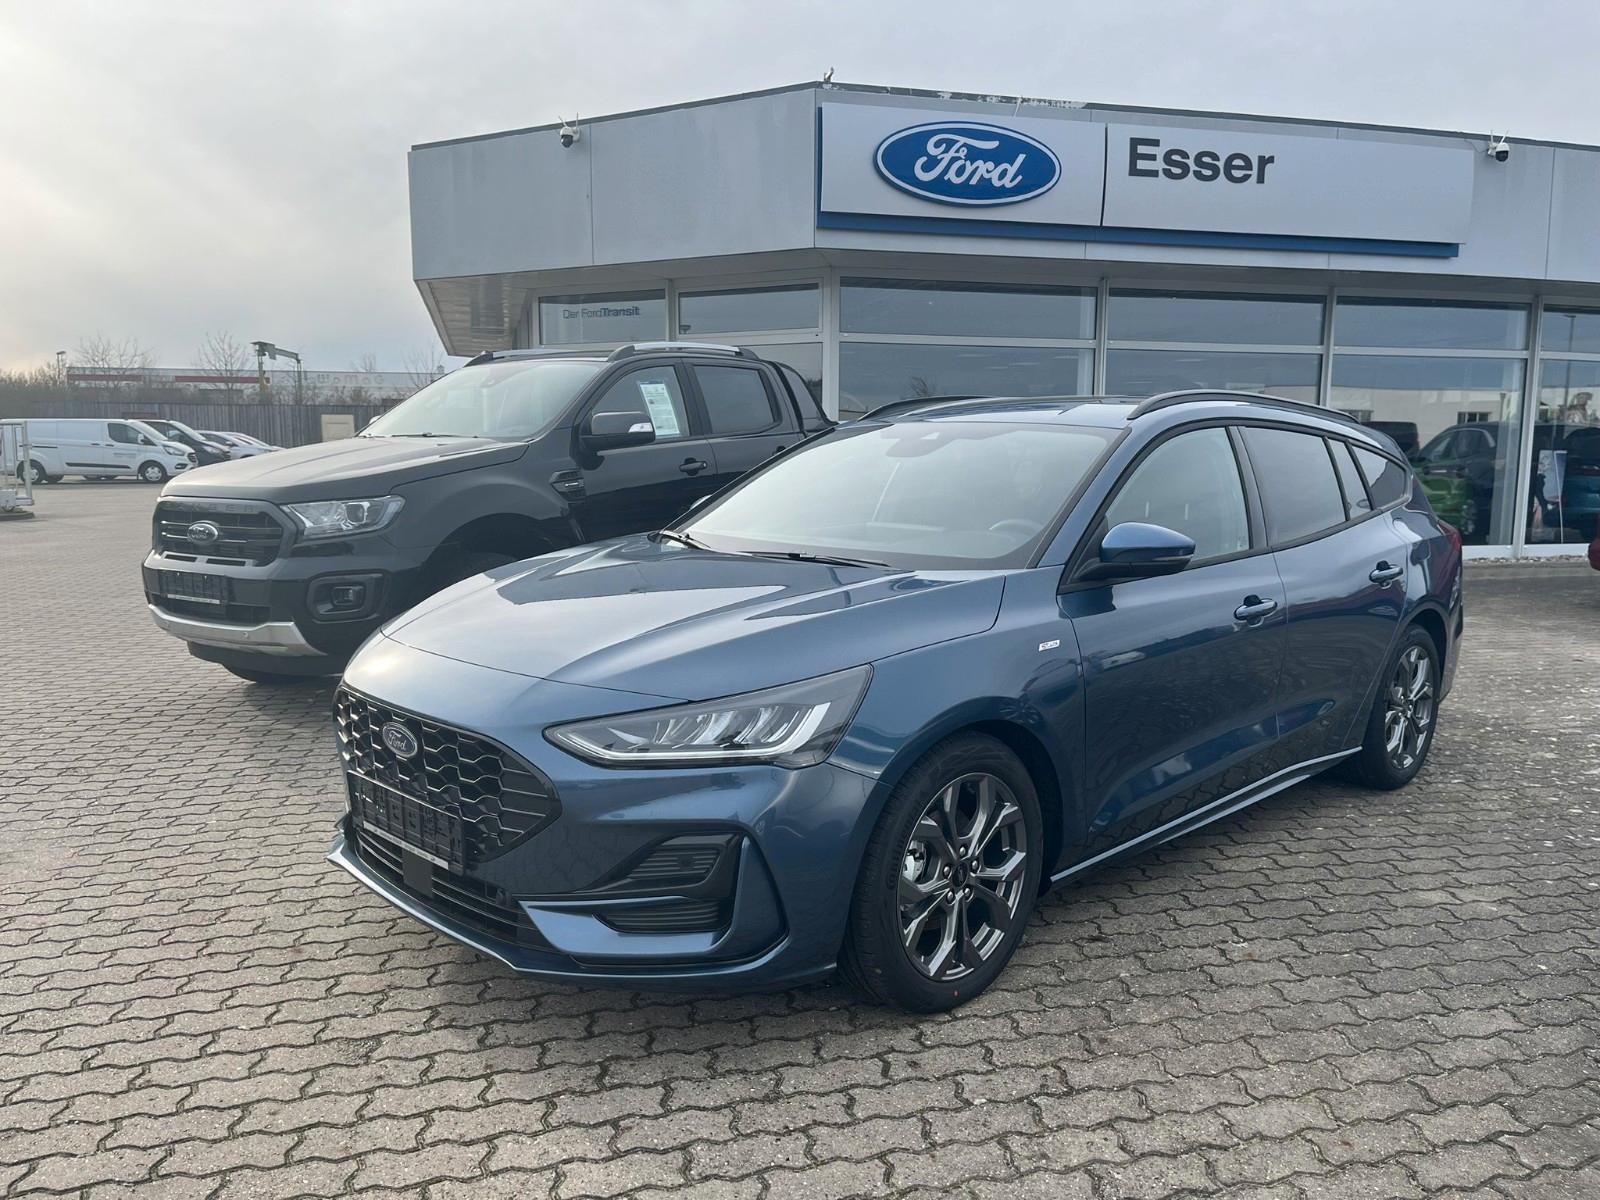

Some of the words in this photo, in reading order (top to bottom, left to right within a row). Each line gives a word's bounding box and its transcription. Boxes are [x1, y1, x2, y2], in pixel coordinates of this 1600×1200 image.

[914, 133, 1026, 188] Ford
[1128, 137, 1275, 184] Esser
[562, 309, 579, 319] Der
[388, 730, 407, 751] Ford
